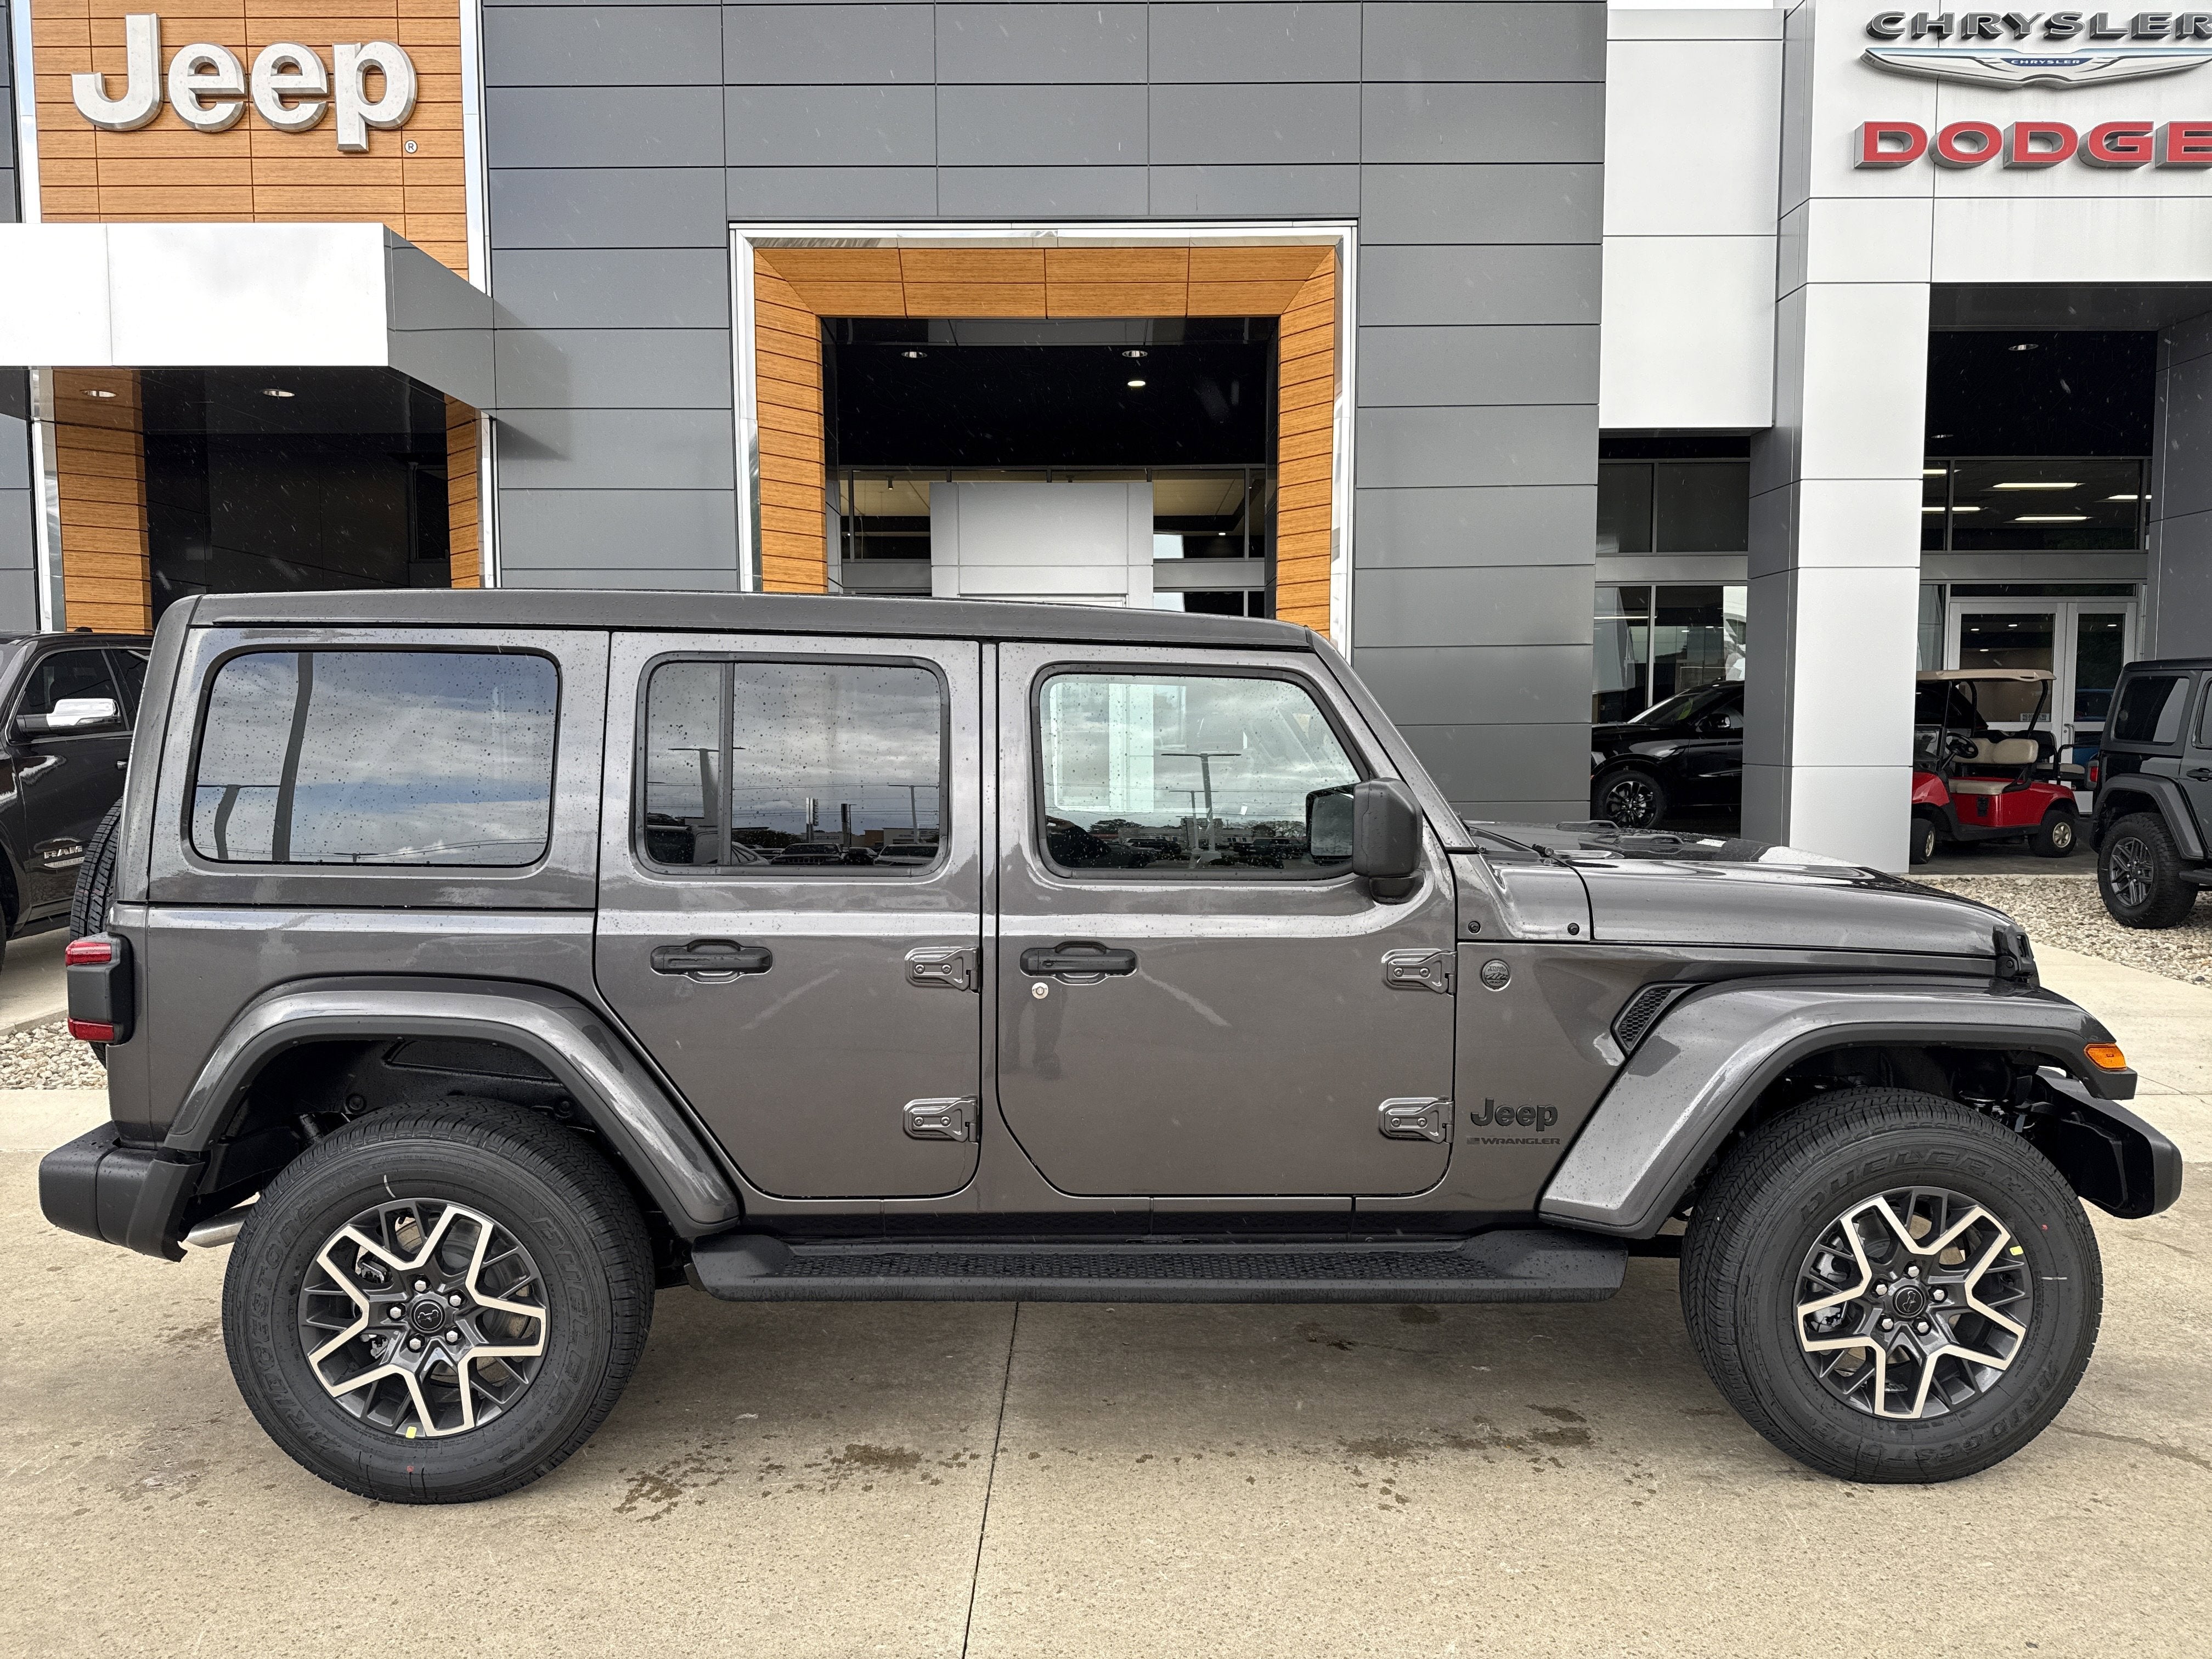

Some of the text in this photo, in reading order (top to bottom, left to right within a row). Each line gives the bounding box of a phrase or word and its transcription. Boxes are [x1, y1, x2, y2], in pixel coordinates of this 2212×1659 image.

[1866, 12, 2212, 39] CHRYSLER
[71, 13, 419, 153] Jeep
[1854, 121, 2212, 168] DODGE
[44, 845, 83, 859] RAM
[1471, 1098, 1558, 1131] Jeep
[1800, 1149, 1995, 1224] DUELER
[250, 1203, 343, 1454] BRIDGESTONE
[529, 1217, 589, 1415] DUELER
